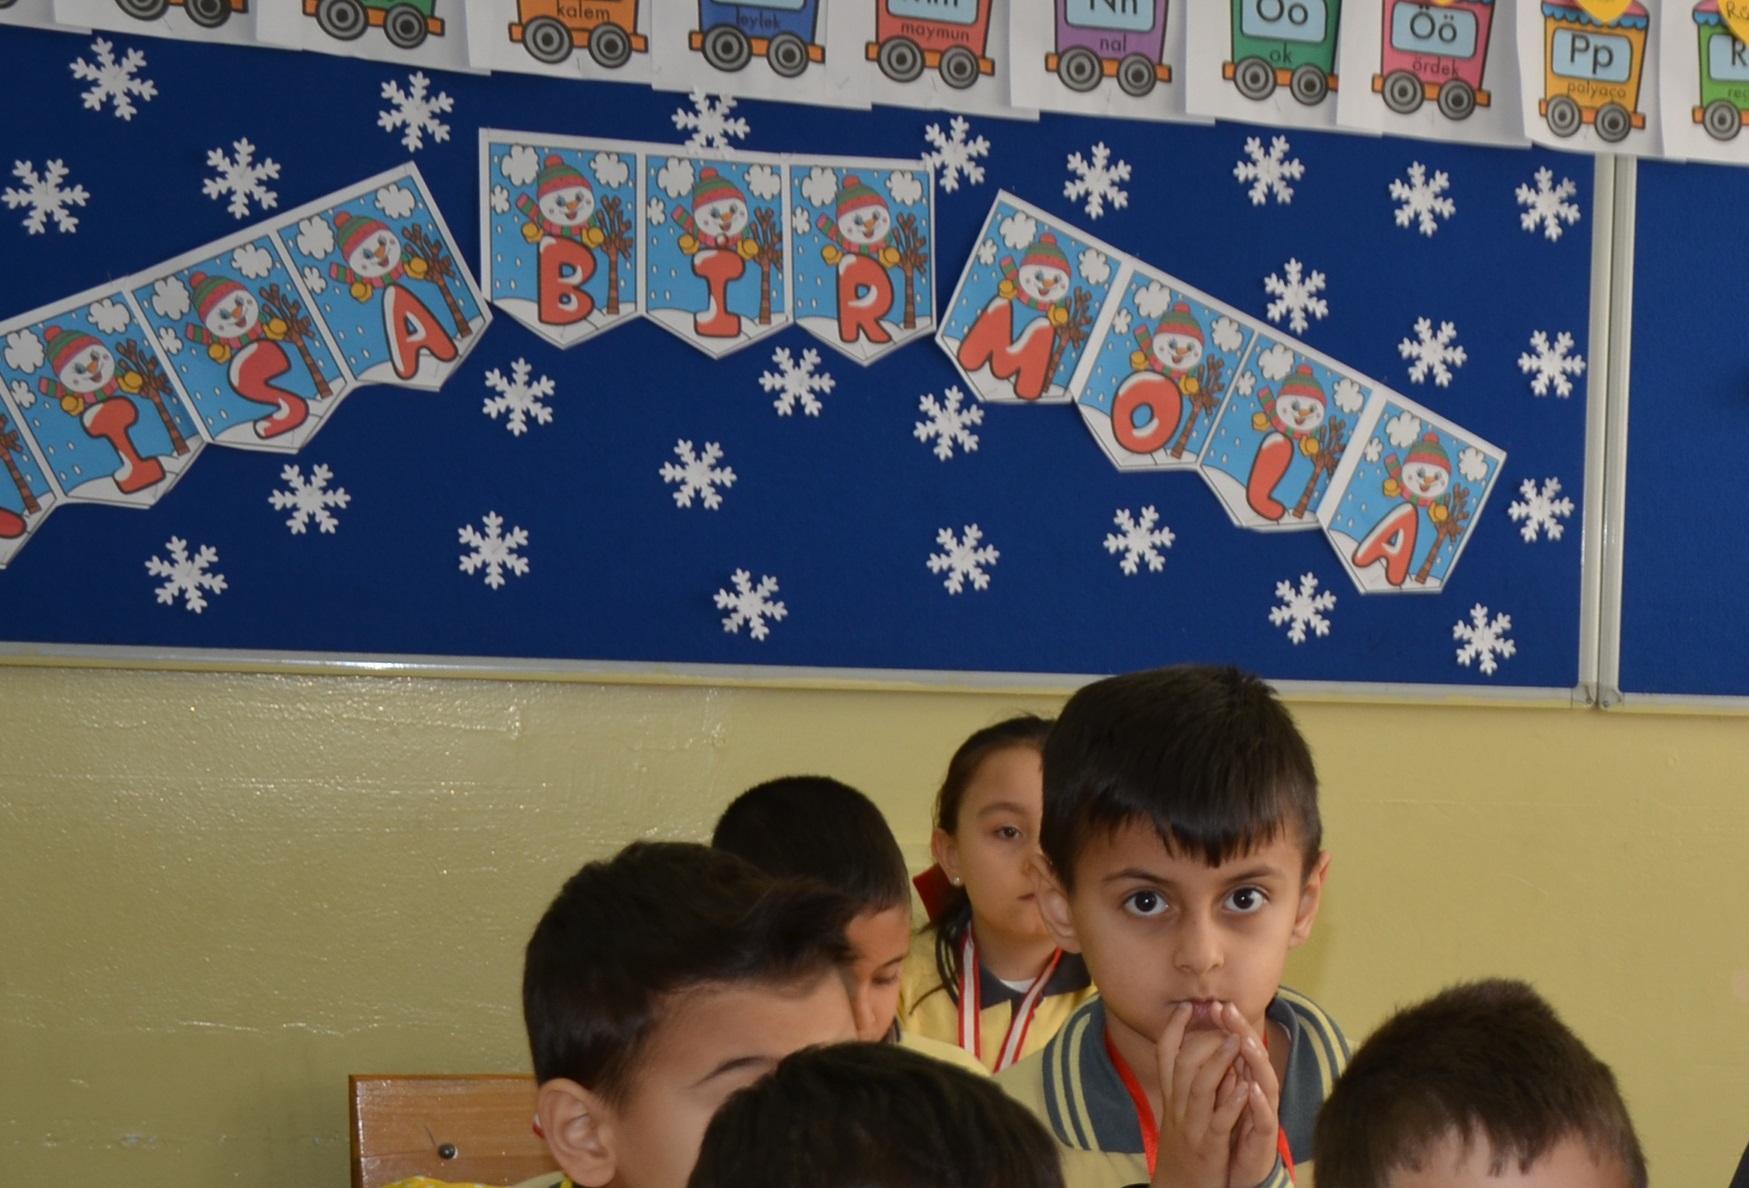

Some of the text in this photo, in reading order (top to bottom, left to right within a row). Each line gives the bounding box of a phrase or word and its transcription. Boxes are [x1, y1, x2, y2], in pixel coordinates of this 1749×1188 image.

[556, 0, 610, 20] kalem
[735, 6, 780, 31] leylek
[901, 22, 970, 42] maymun
[1409, 4, 1457, 43] Öö
[1100, 32, 1127, 52] nal
[1269, 40, 1292, 64] ok
[1570, 32, 1613, 75] Pp
[1412, 55, 1459, 79] ördek
